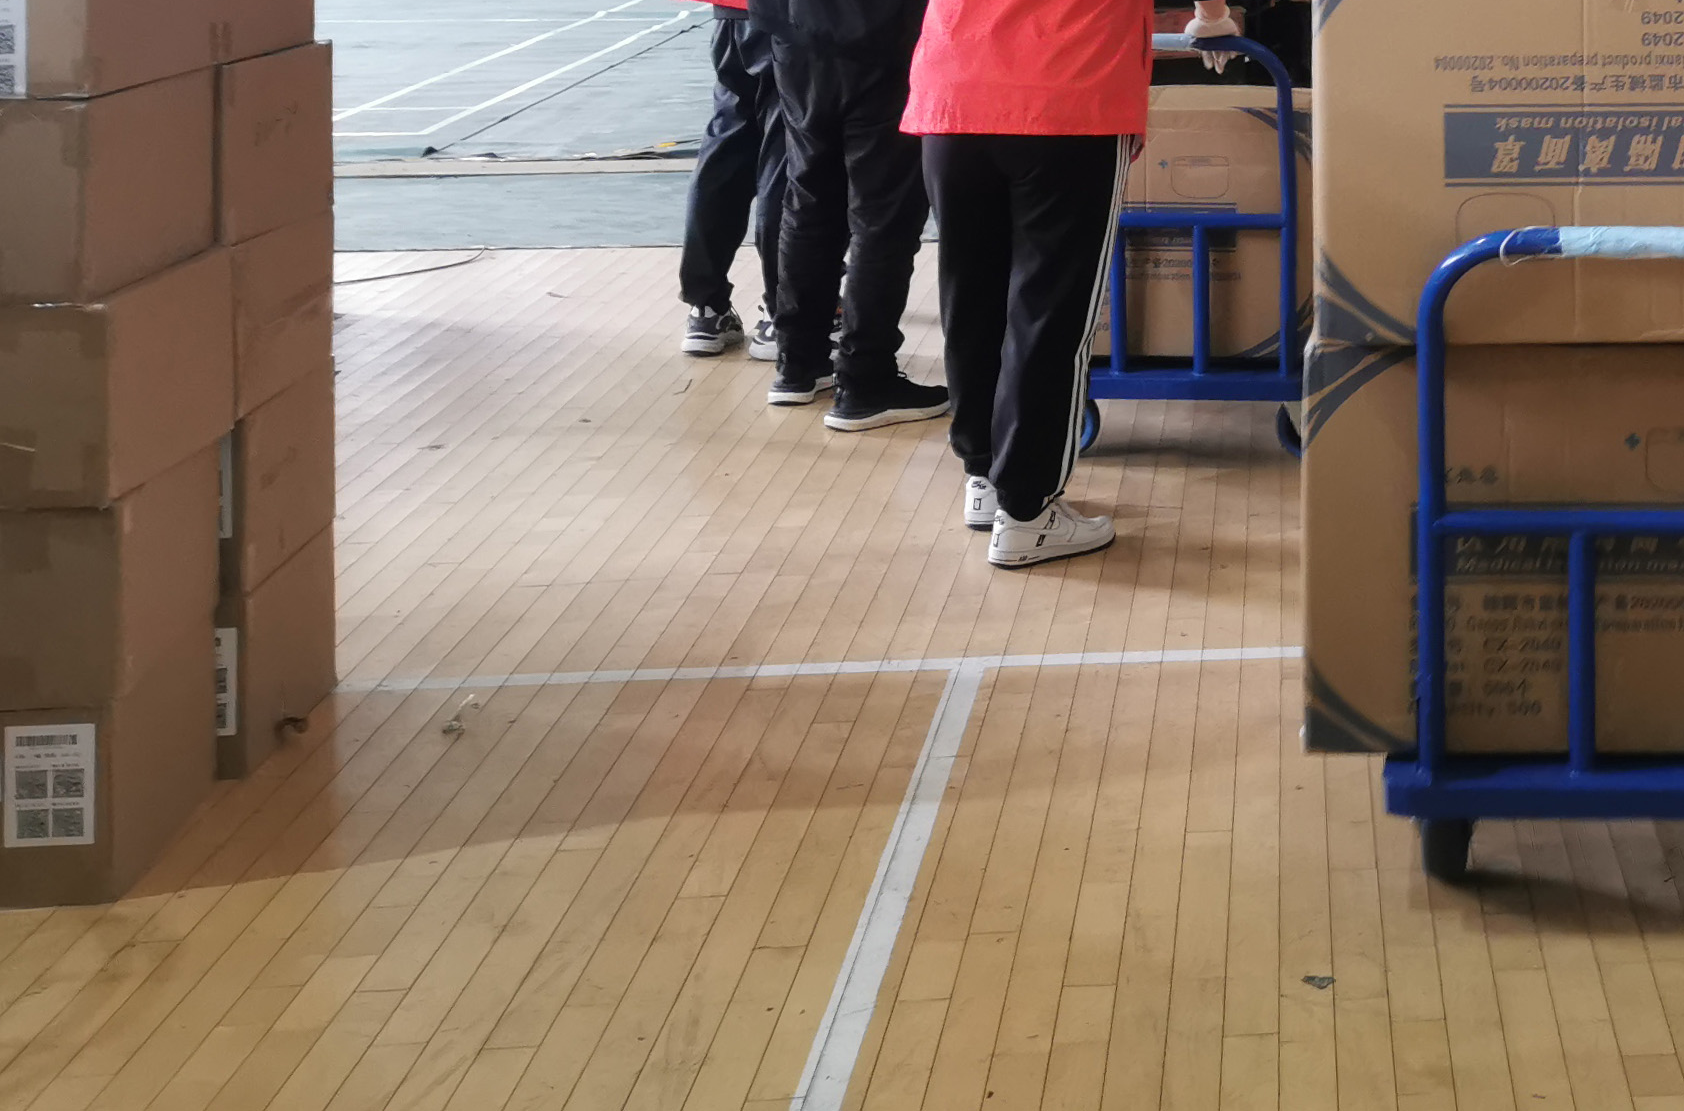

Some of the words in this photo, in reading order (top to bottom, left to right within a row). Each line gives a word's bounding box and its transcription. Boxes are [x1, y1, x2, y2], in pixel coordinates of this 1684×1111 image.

[1523, 51, 1599, 70] preparation
[1601, 52, 1652, 71] product
[1493, 116, 1555, 132] mask
[1561, 115, 1659, 132] isolation
